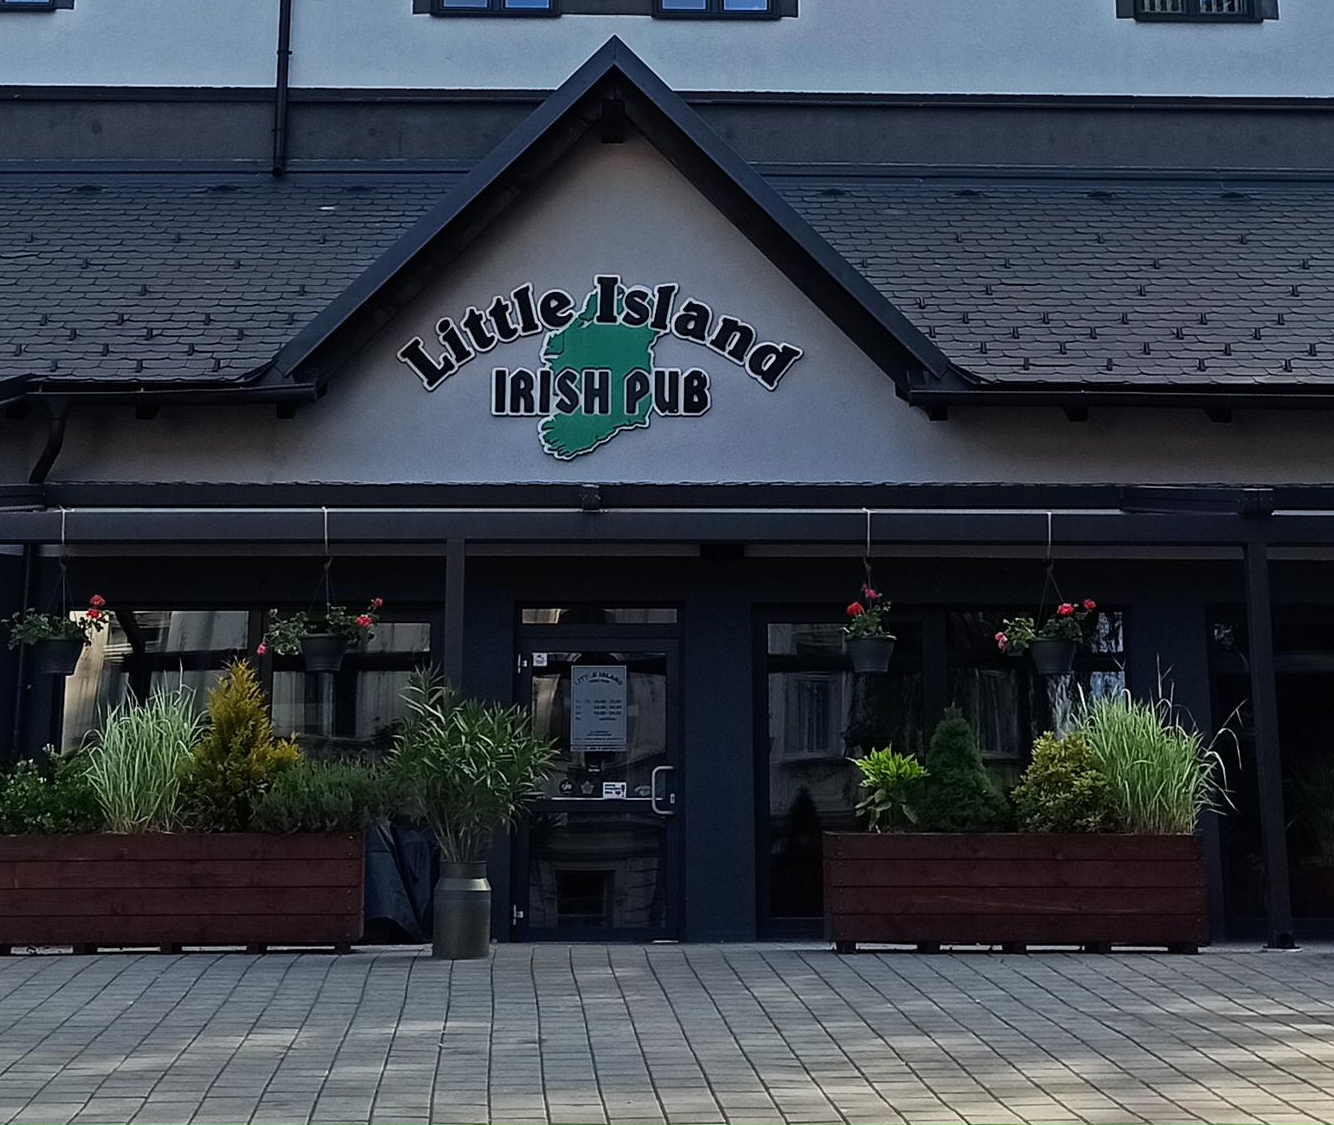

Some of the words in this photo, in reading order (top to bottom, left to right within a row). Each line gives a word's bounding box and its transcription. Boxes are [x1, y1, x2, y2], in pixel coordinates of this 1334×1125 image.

[396, 281, 576, 392] Little
[593, 274, 804, 392] Island
[490, 367, 612, 417] IRISH
[623, 367, 713, 417] PUB
